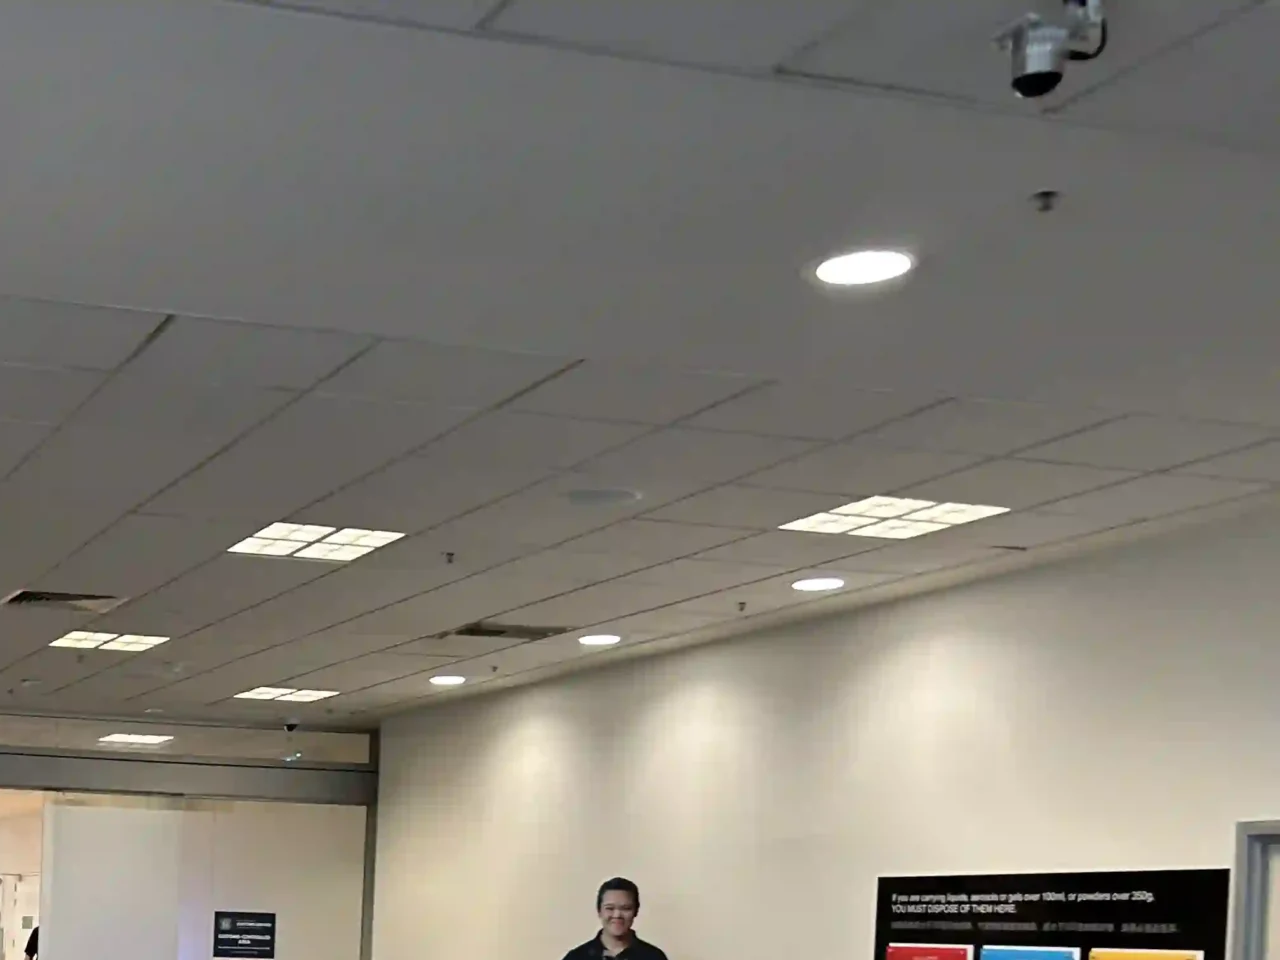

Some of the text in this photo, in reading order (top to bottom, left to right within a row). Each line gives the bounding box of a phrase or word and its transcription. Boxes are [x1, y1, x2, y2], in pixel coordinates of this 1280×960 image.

[1112, 892, 1130, 901] over
[892, 904, 907, 913] YOU
[908, 904, 927, 913] MUST
[927, 904, 959, 913] DISPOSE
[960, 904, 970, 913] OF
[971, 904, 993, 913] THEM
